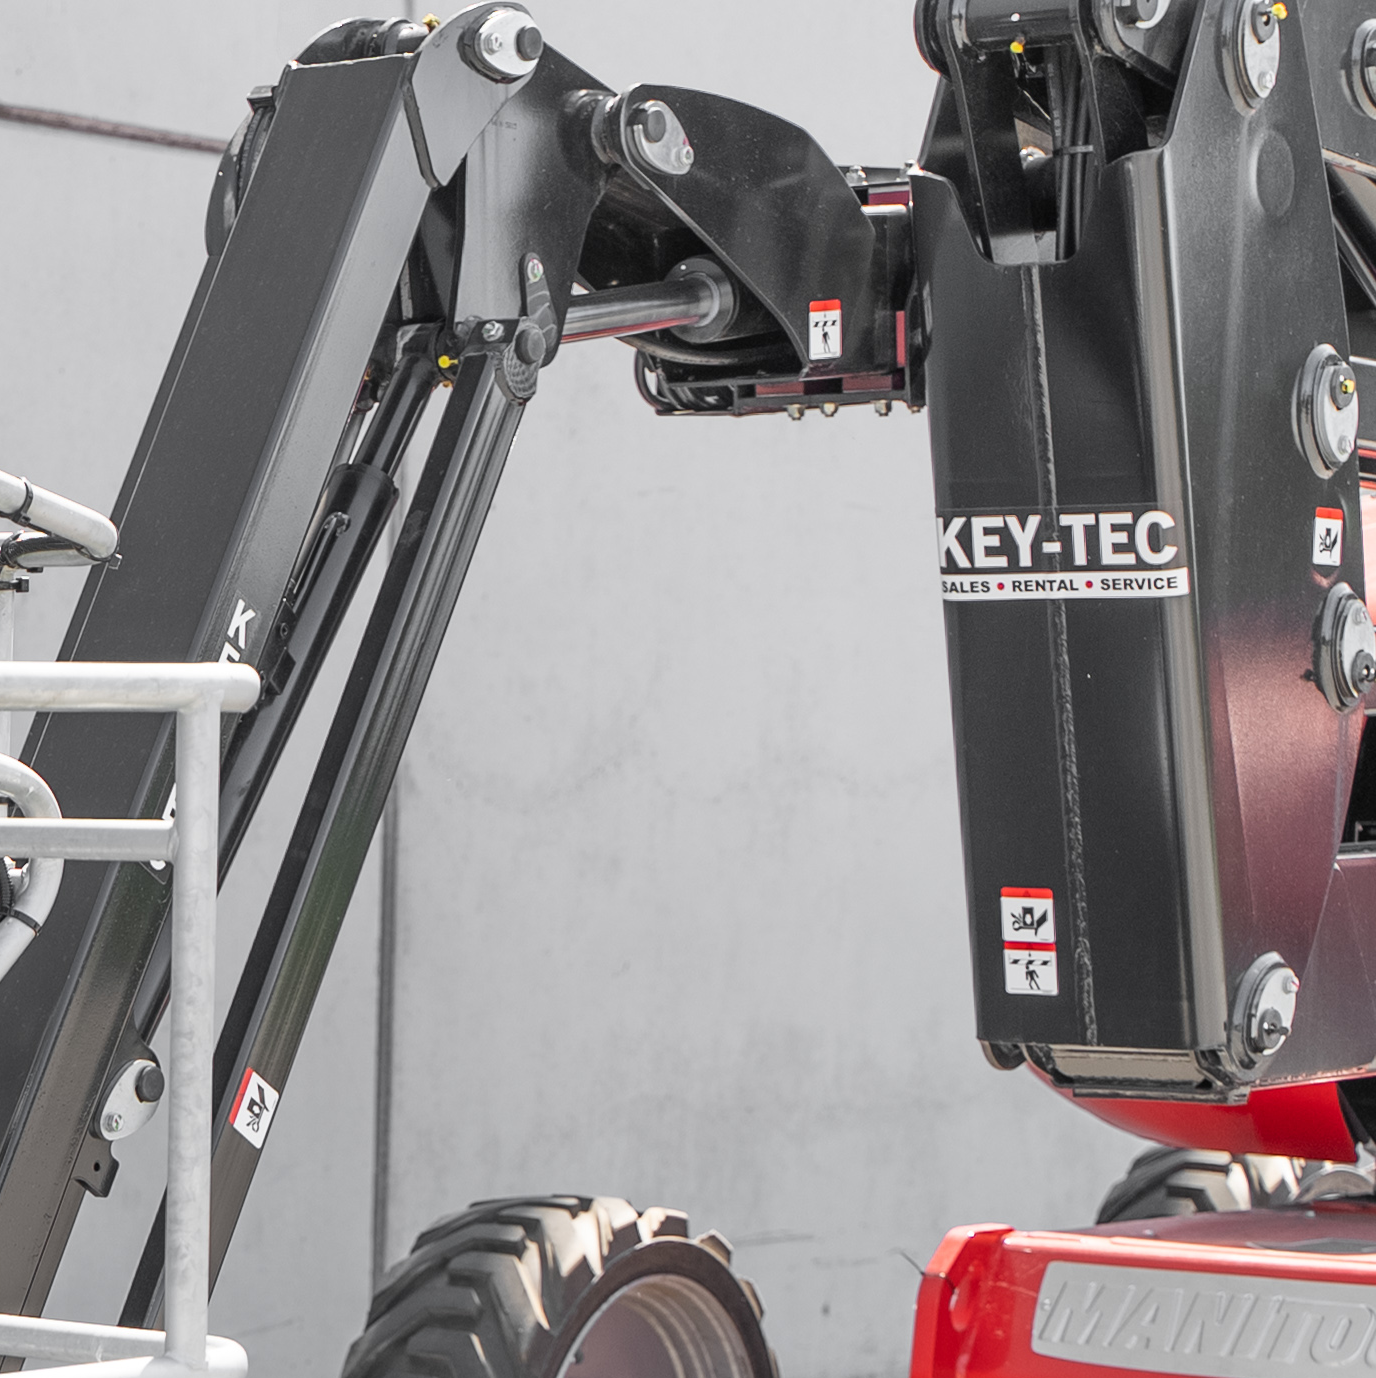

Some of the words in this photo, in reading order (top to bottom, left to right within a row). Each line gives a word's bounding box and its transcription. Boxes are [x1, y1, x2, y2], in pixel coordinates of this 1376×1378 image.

[936, 510, 1179, 568] KEY-TEC
[942, 581, 991, 593] SALES
[1012, 579, 1079, 592] RENTAL
[1101, 577, 1178, 591] SERVICE
[1038, 1281, 1376, 1368] MANITO
